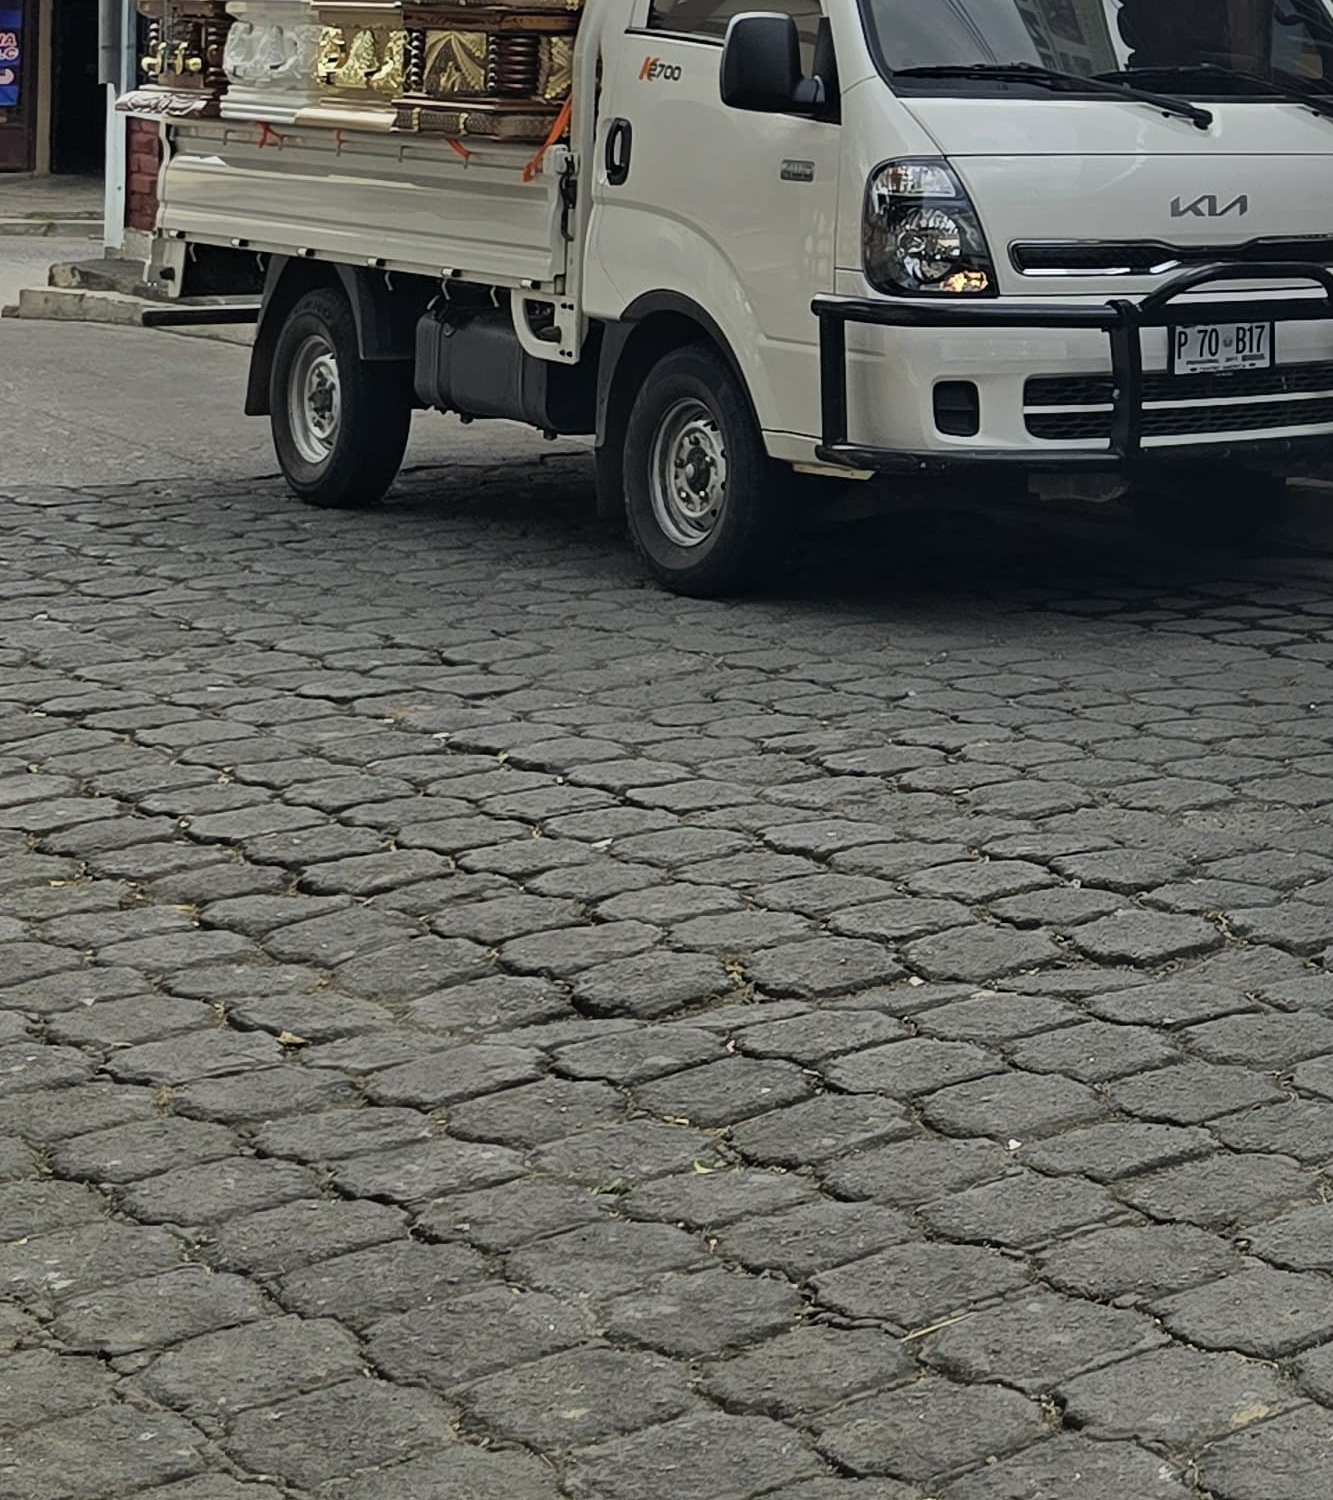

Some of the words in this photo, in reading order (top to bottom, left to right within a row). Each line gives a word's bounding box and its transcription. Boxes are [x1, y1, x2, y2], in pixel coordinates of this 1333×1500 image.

[638, 56, 683, 82] K2700
[1169, 194, 1248, 218] KIA
[1177, 330, 1189, 360] P
[1197, 328, 1220, 358] 70
[1235, 325, 1266, 355] B17
